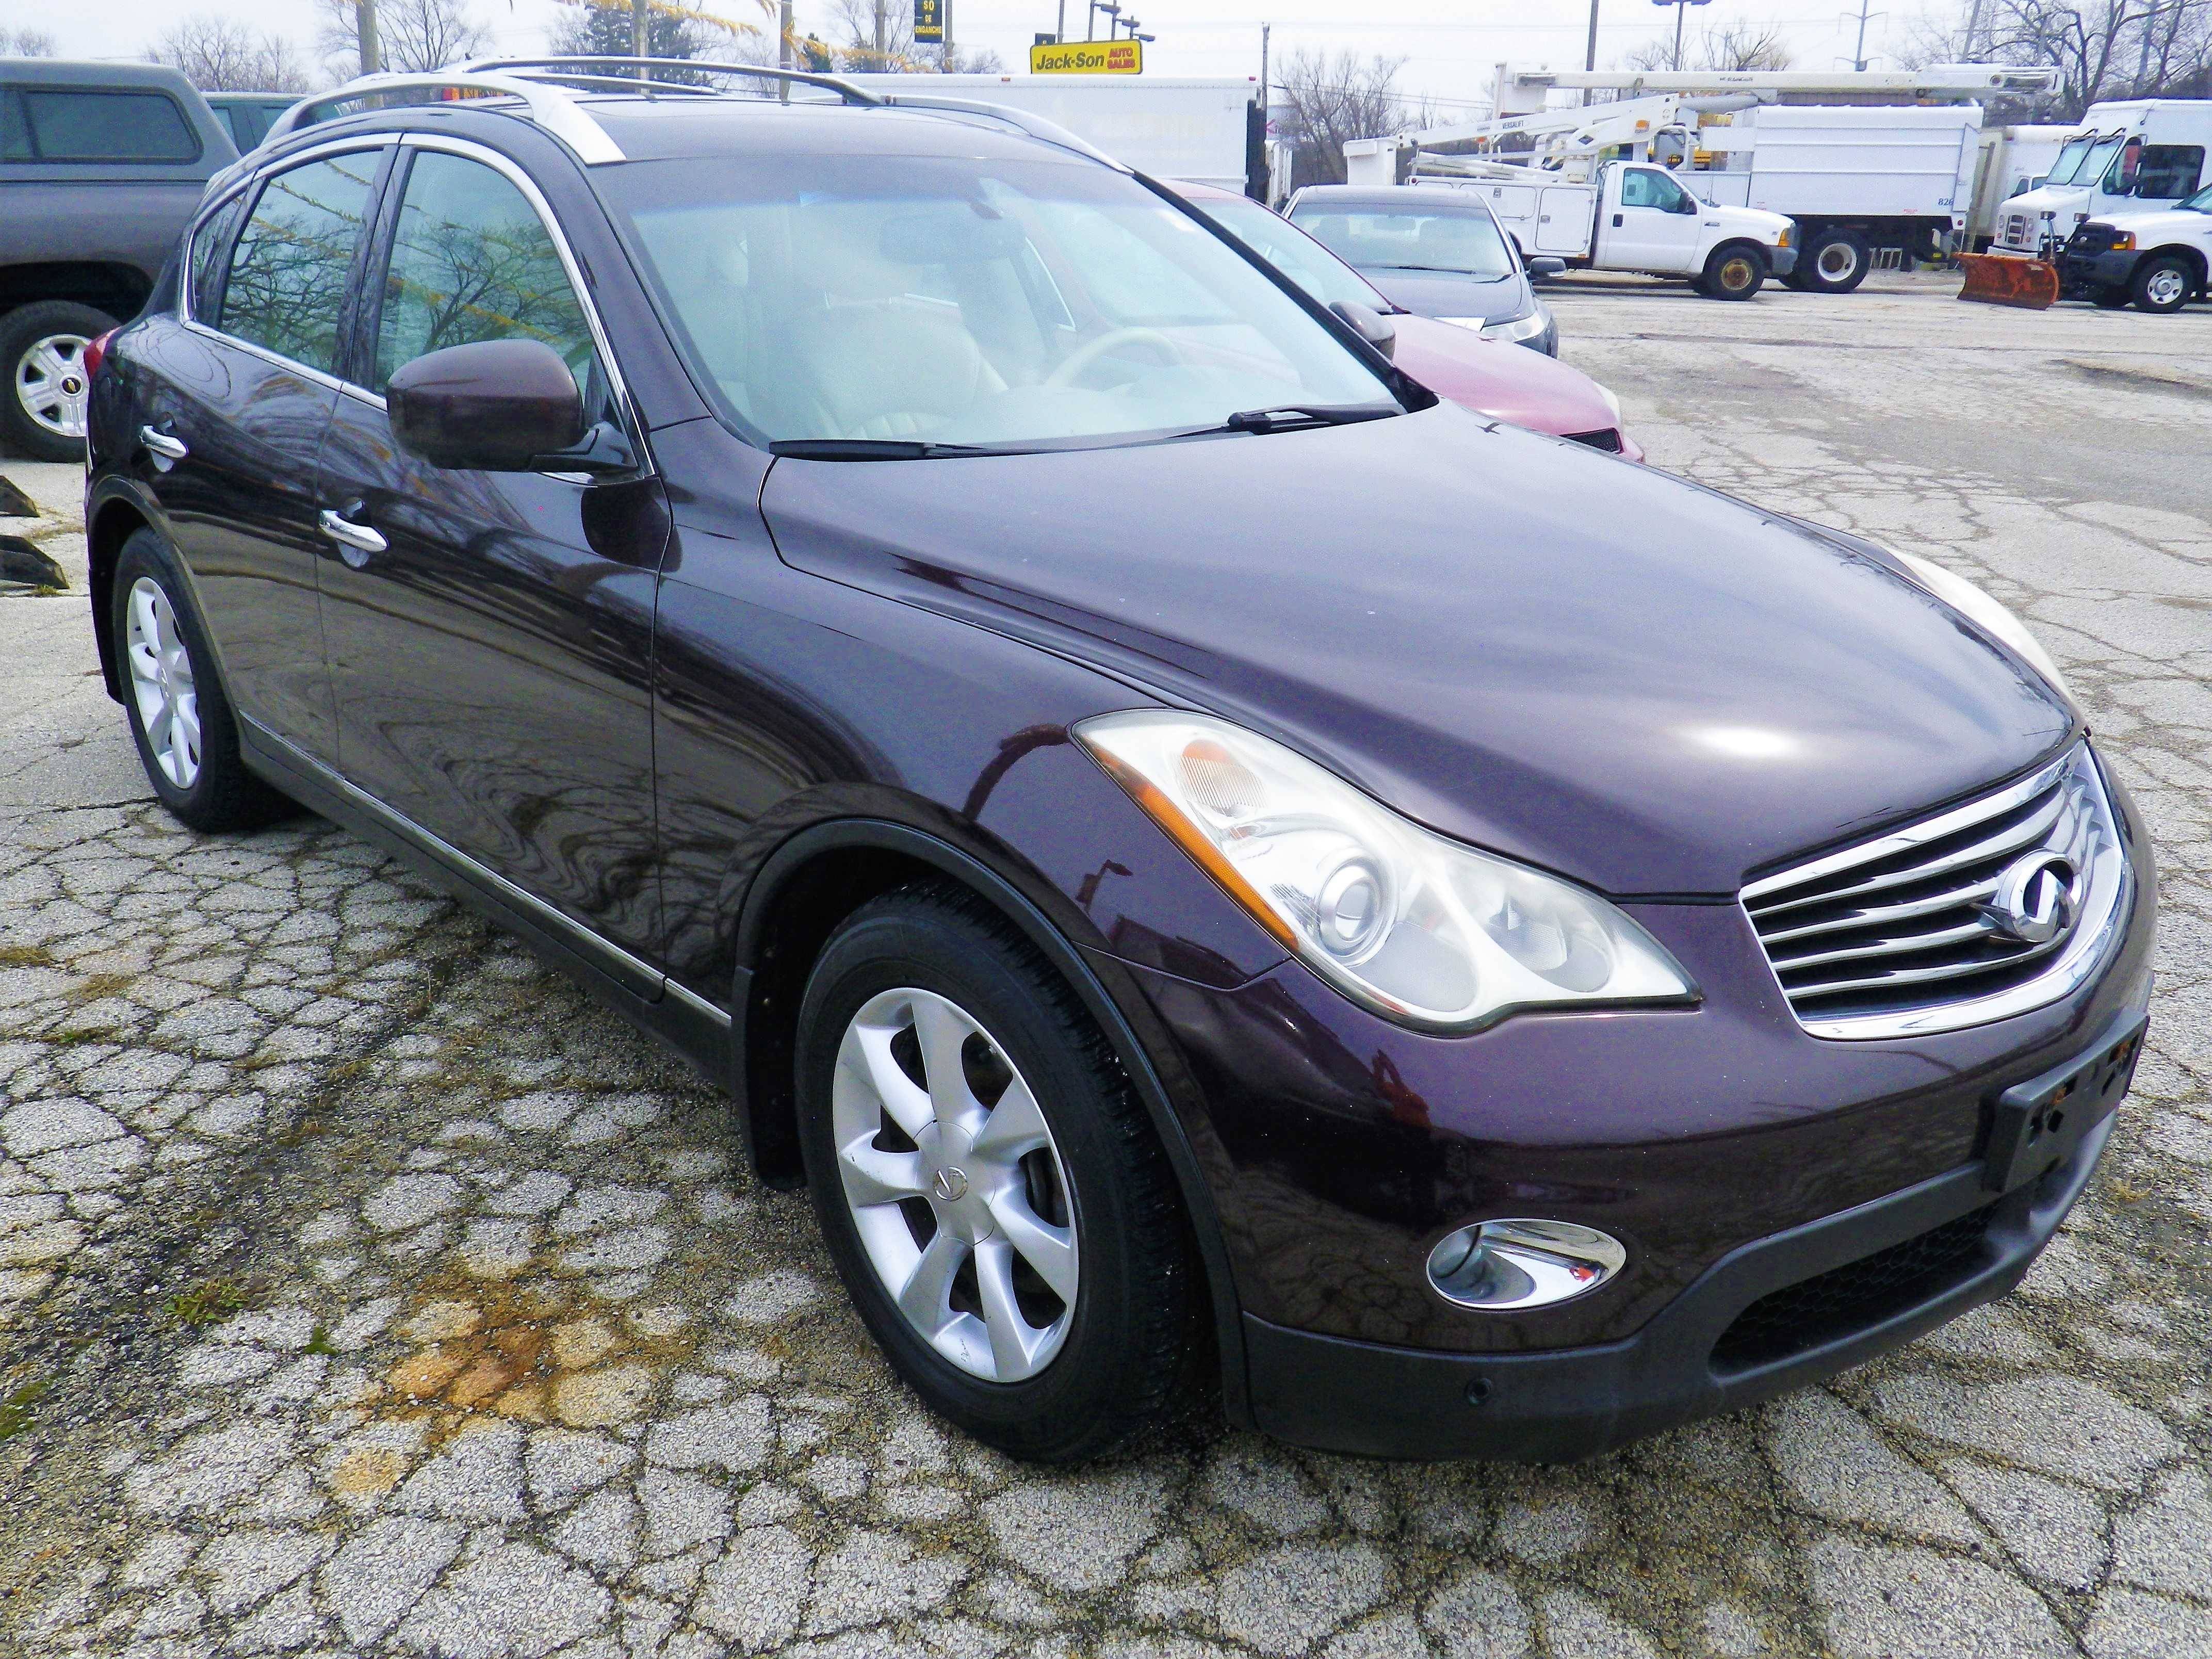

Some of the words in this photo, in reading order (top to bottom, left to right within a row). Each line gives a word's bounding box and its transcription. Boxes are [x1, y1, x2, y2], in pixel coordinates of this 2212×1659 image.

[1109, 48, 1133, 58] AUTO
[1036, 52, 1104, 70] Jack-Son
[1107, 58, 1135, 69] SALES
[1502, 120, 1524, 129] VERSALIFT
